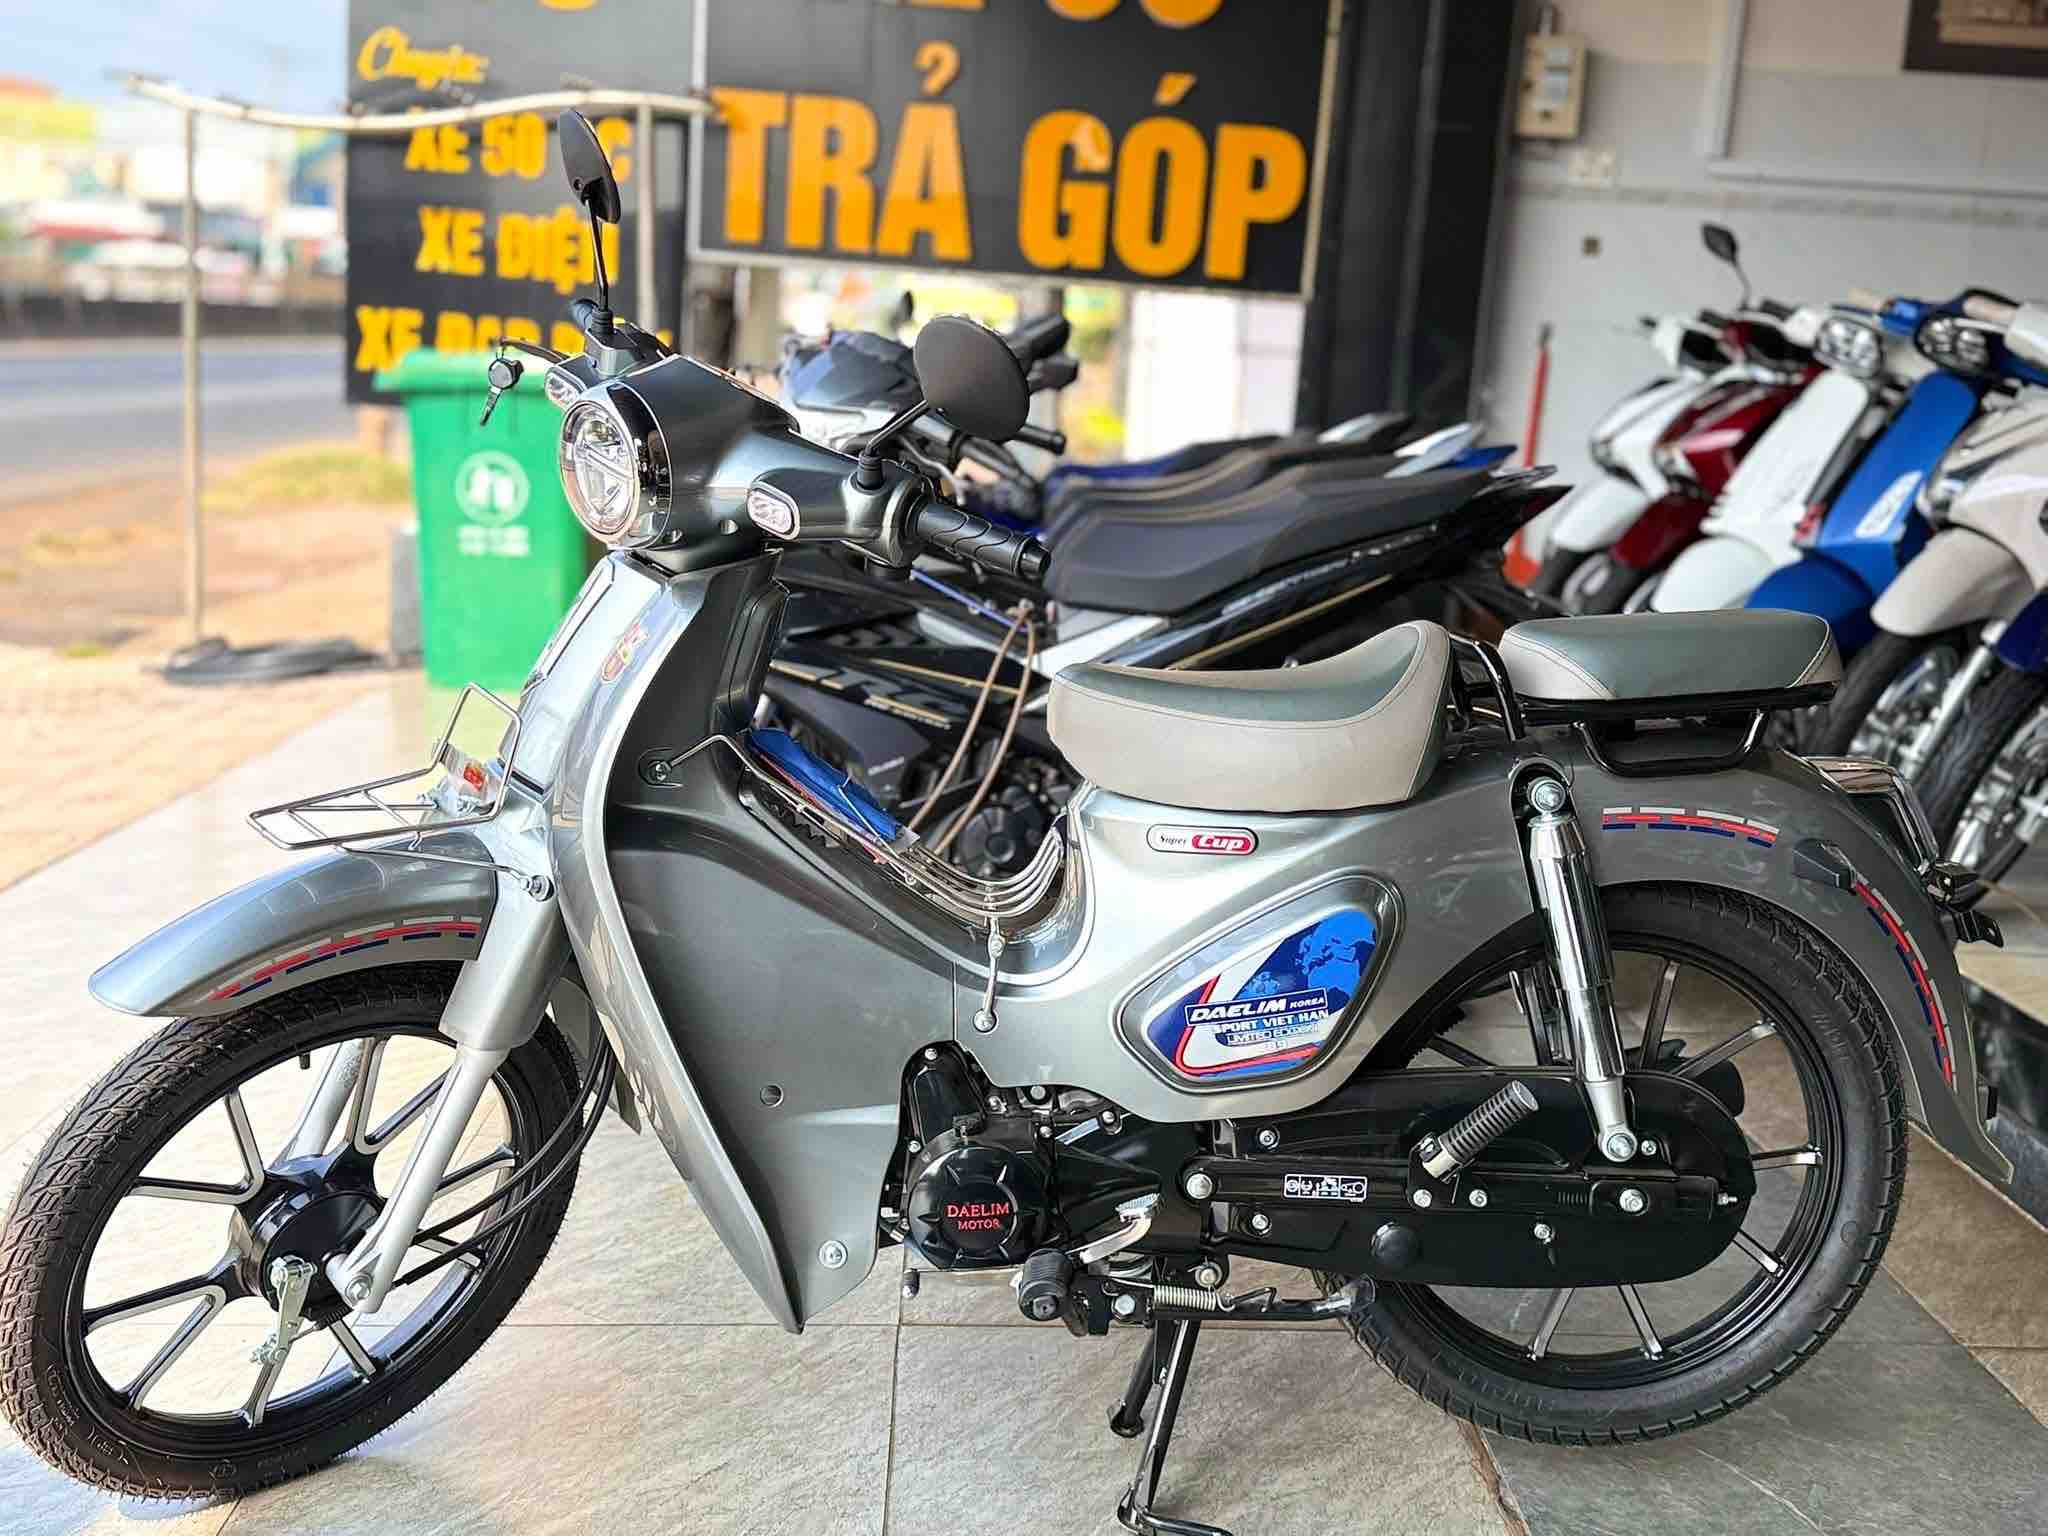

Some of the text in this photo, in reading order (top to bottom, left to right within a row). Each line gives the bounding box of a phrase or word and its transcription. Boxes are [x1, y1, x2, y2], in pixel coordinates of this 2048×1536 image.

[709, 40, 1307, 281] TRẢ GÓP
[415, 206, 487, 277] XE
[1197, 834, 1246, 851] Cup
[1189, 998, 1288, 1022] DAELIM
[946, 1202, 1010, 1218] DAELIM
[957, 1218, 1001, 1231] MOTOR
